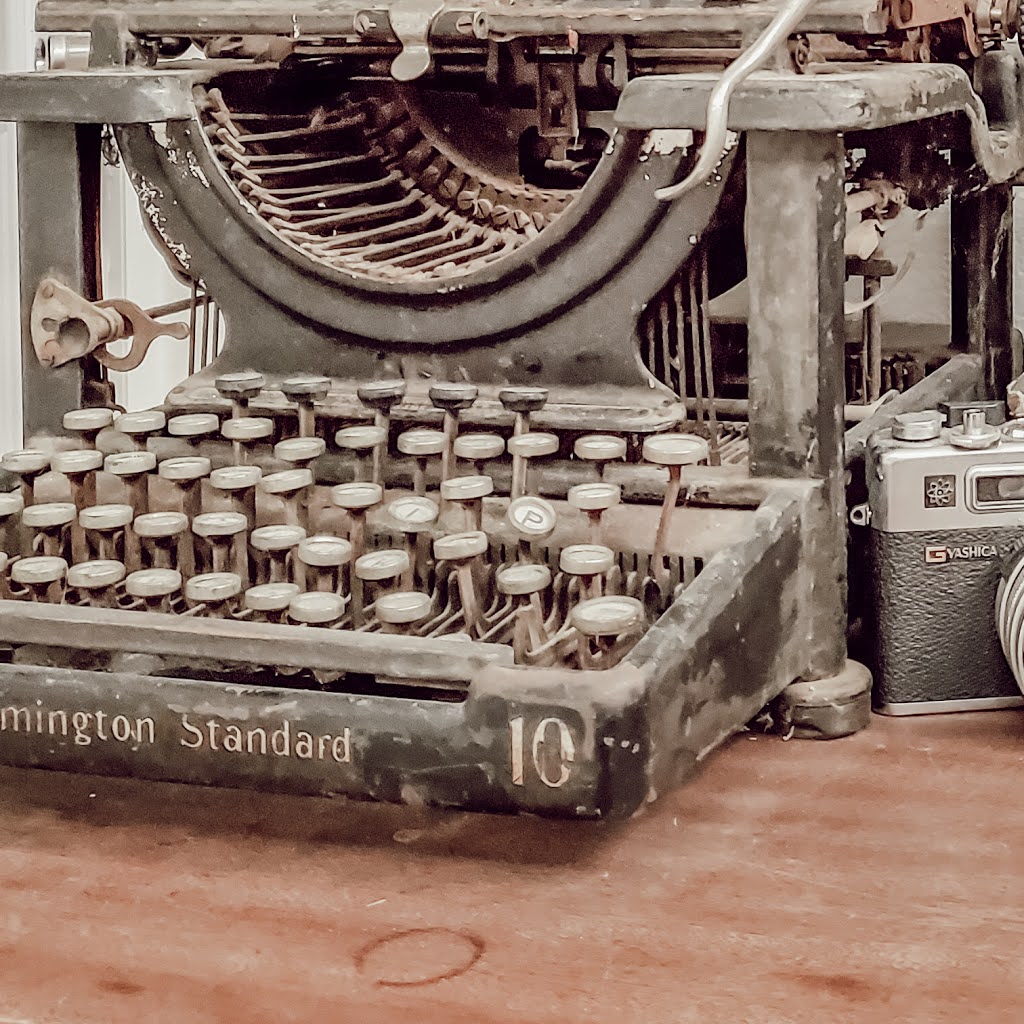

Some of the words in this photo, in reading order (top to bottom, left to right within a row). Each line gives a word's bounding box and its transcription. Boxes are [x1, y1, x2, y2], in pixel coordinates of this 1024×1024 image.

[520, 510, 544, 525] P
[946, 546, 997, 558] YASHICA
[181, 714, 350, 763] Standard
[509, 717, 575, 788] 10
